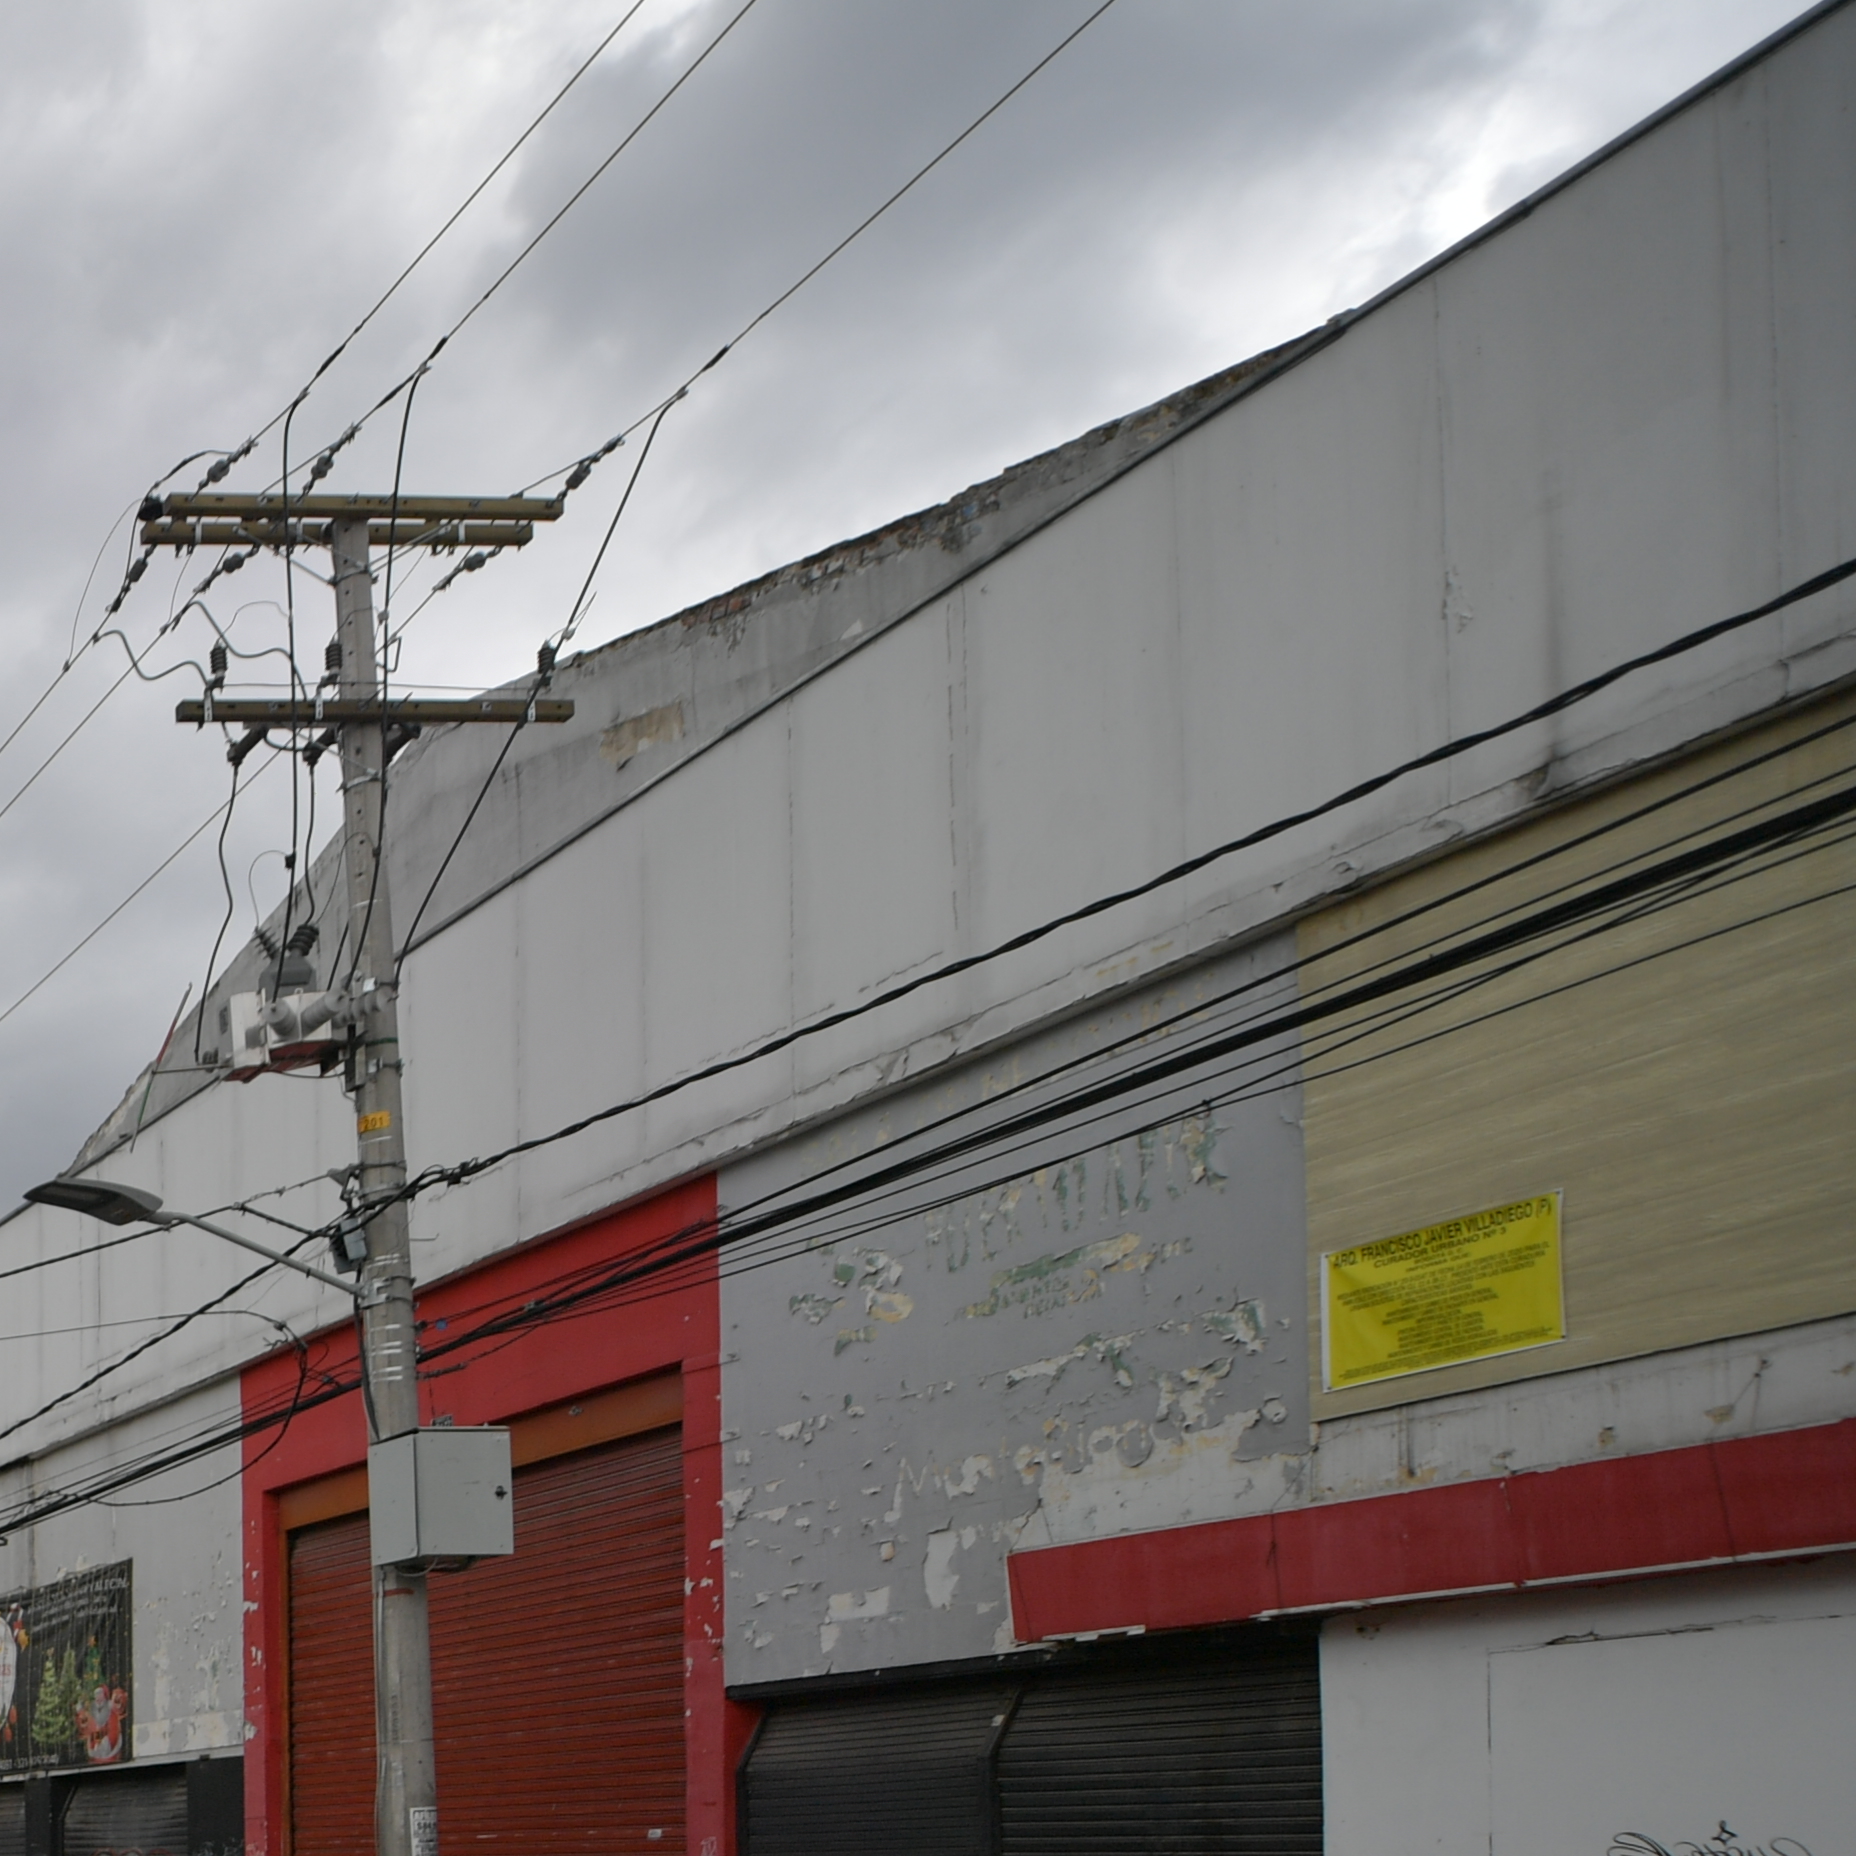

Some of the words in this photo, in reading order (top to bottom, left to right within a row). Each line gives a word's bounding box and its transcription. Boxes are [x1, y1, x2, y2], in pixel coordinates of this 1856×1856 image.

[1360, 1233, 1422, 1262] FRANCISCO
[1424, 1221, 1462, 1245] JAVIER
[1464, 1202, 1532, 1234] VILLADIEGO
[1373, 1247, 1429, 1269] CURADOR
[1431, 1233, 1480, 1254] URBANO
